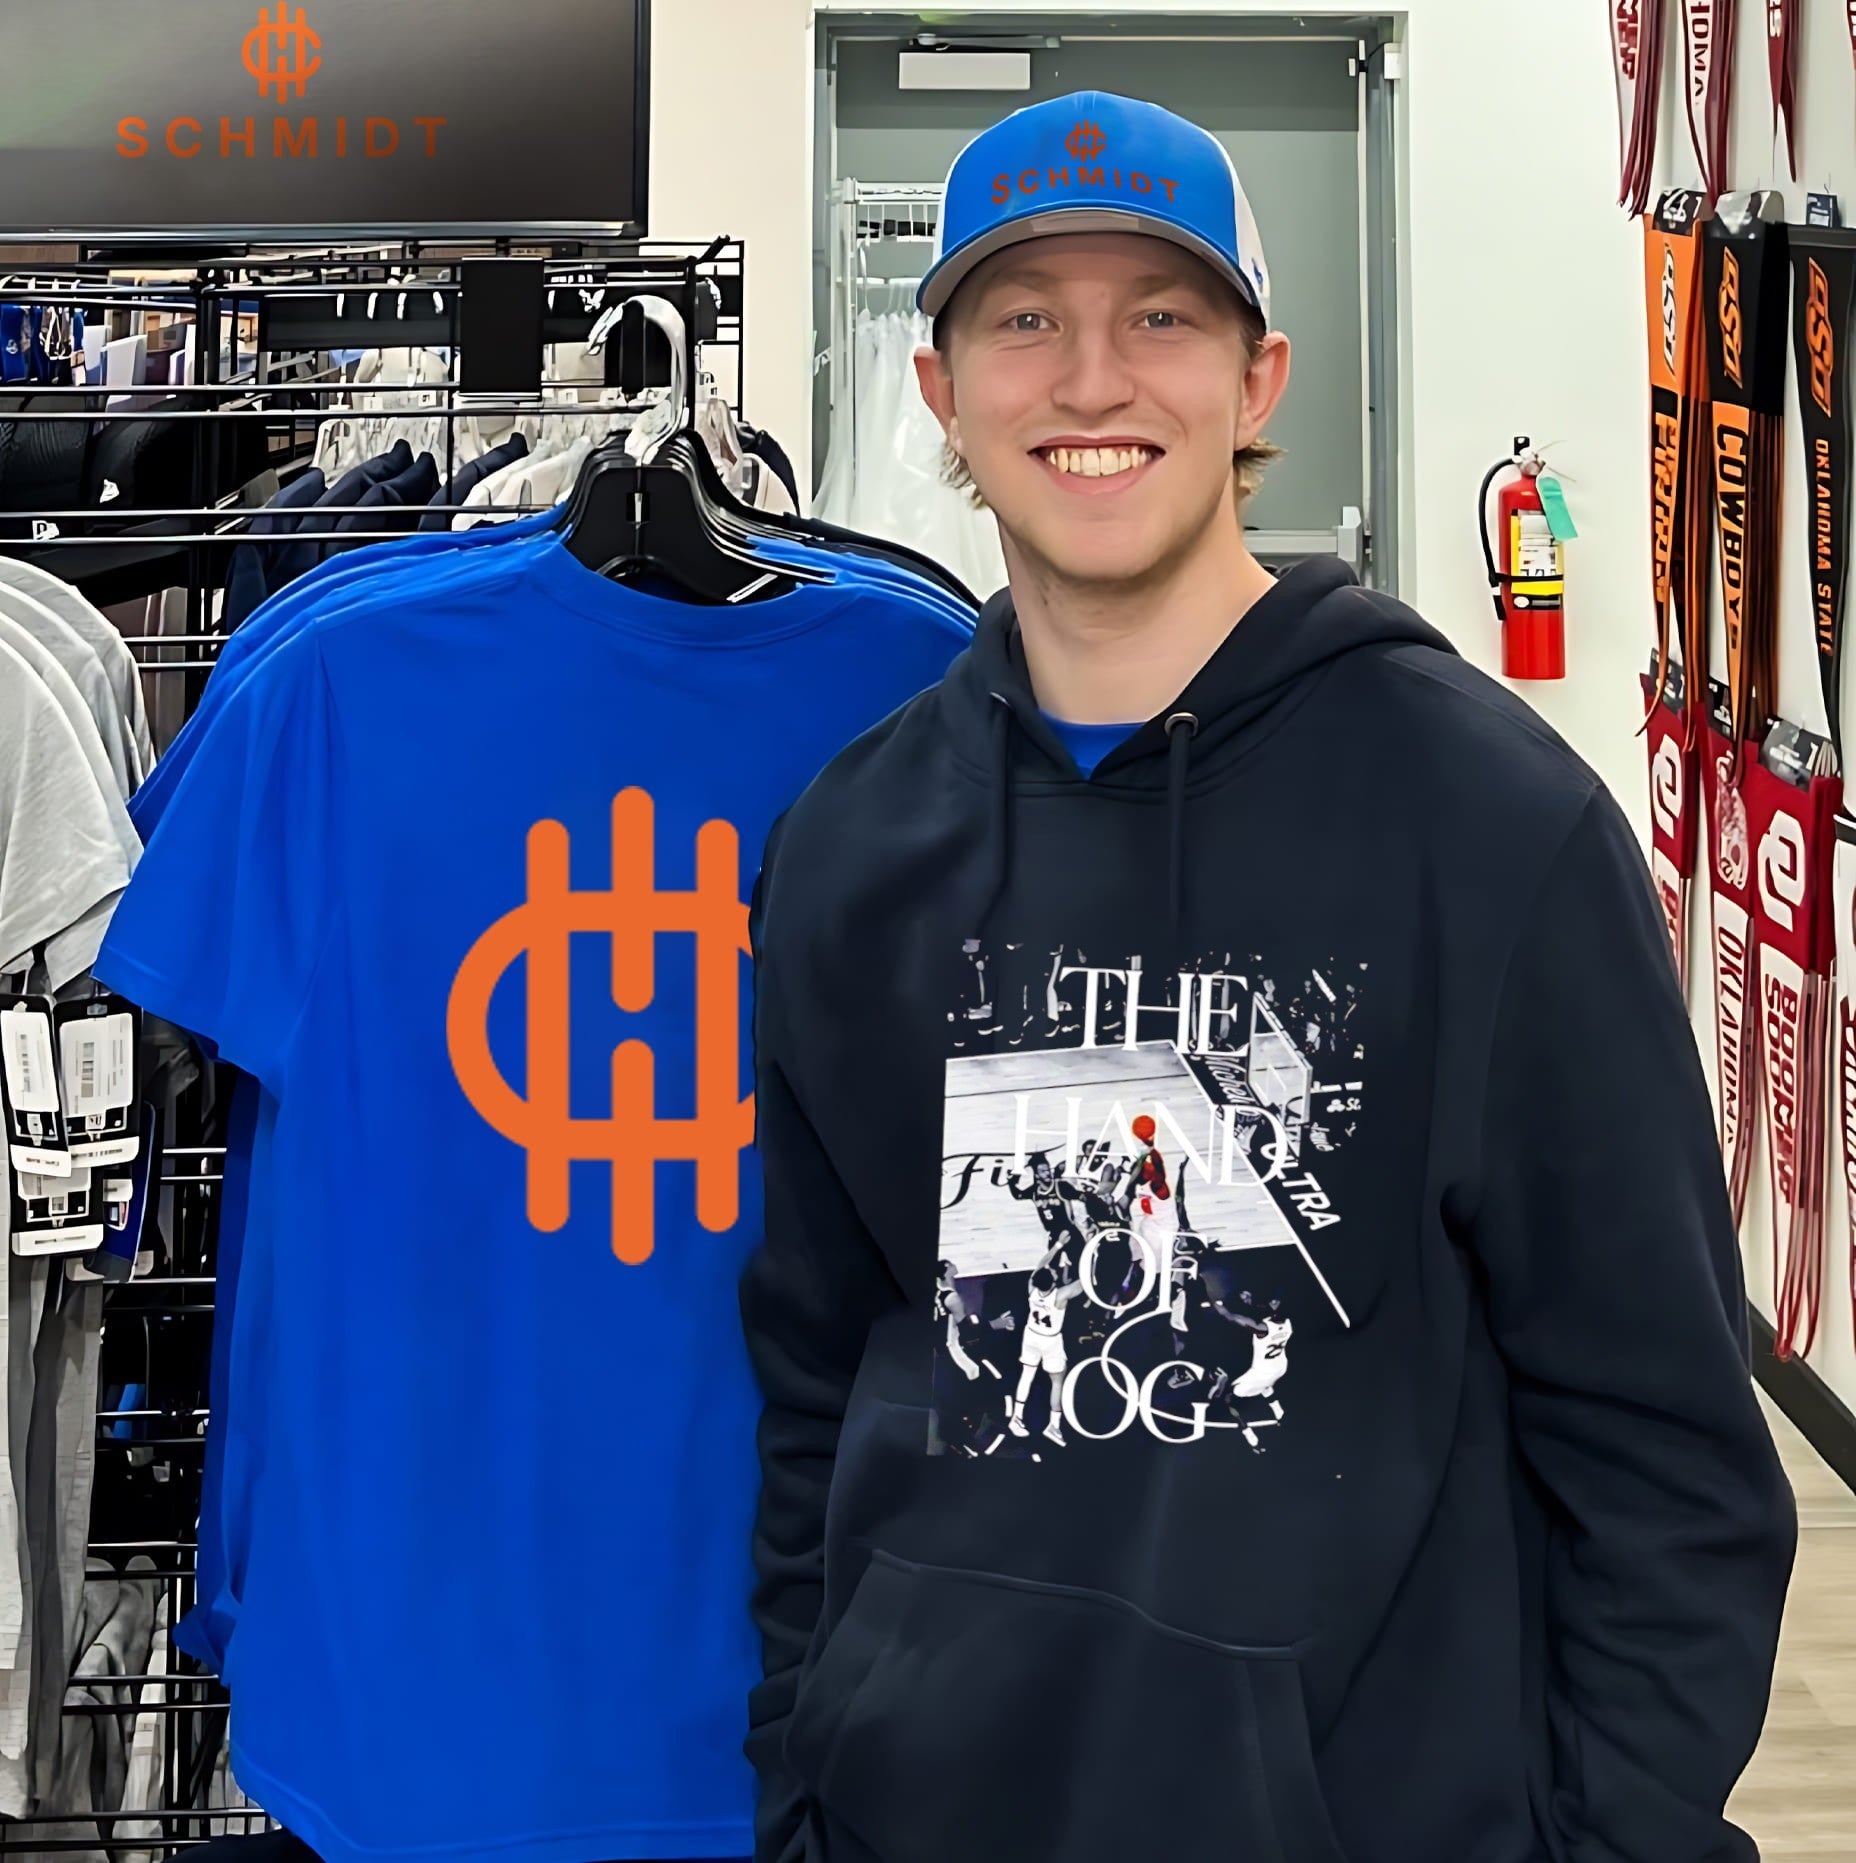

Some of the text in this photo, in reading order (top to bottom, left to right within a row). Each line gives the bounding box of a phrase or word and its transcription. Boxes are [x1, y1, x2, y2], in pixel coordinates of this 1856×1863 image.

[115, 117, 448, 159] SCHMIDT
[991, 166, 1180, 204] SCHMIDT
[1814, 437, 1833, 571] OKLAHOMA
[1059, 966, 1250, 1057] THE
[1013, 1094, 1290, 1187] HAND
[1078, 1227, 1209, 1313] OF
[1061, 1356, 1210, 1443] OG
